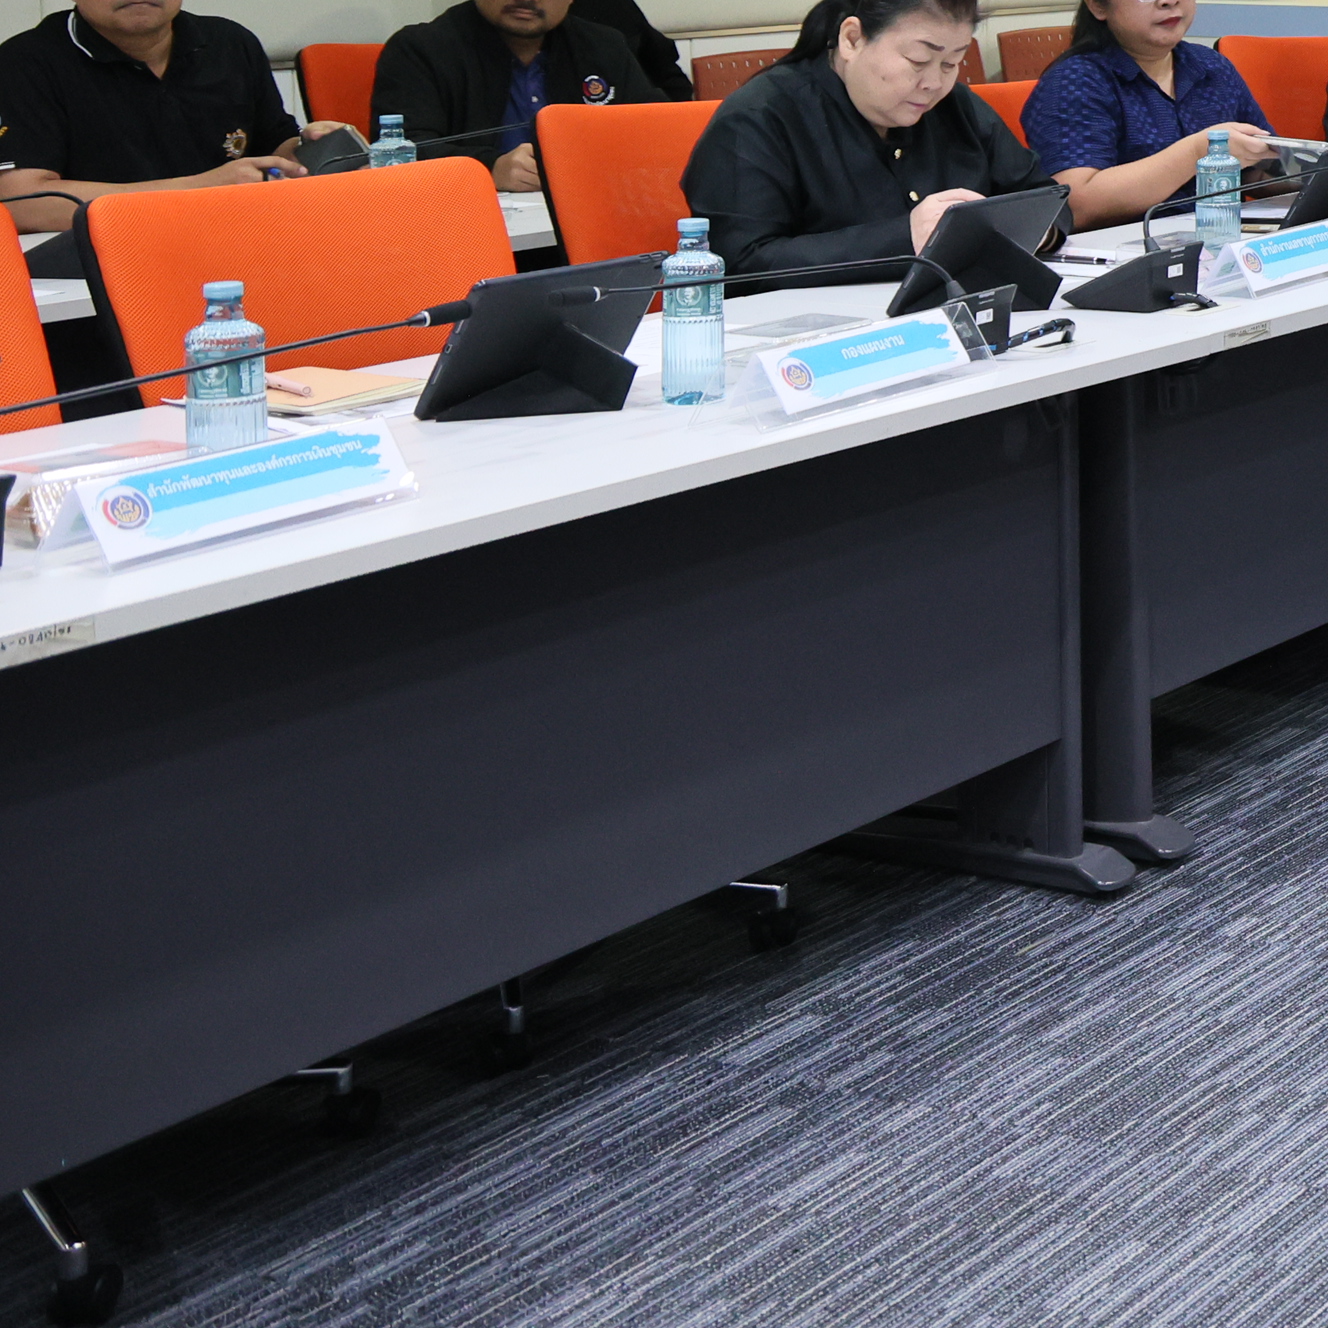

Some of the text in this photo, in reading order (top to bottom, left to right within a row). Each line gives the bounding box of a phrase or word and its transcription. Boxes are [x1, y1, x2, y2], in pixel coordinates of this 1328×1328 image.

[841, 334, 906, 360] กองแผนงาน
[146, 439, 363, 498] สำนักพัฒนาทุนและองค์กรการเงินชุมชน
